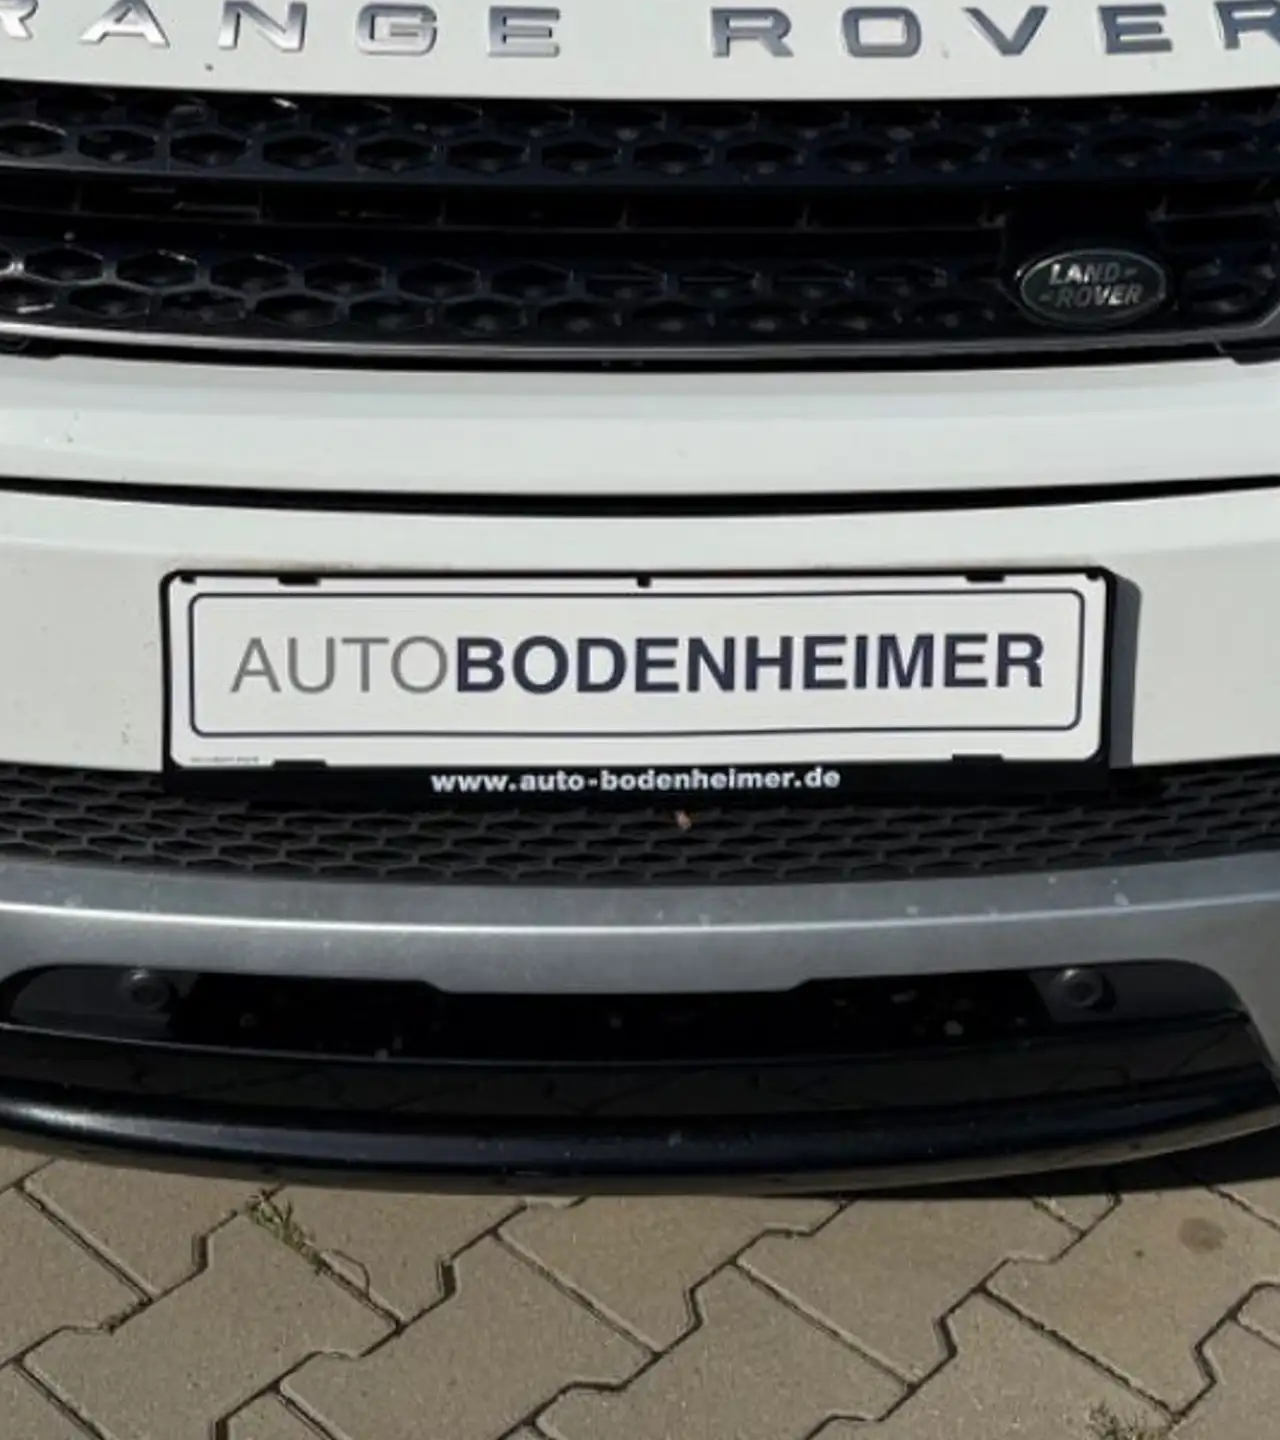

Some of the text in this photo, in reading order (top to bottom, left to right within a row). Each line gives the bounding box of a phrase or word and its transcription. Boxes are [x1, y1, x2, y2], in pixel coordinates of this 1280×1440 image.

[1054, 283, 1144, 308] ROVER
[230, 632, 1045, 695] AUTOBODENHEIMER
[430, 766, 842, 793] www.auto-bodenheimer.de
